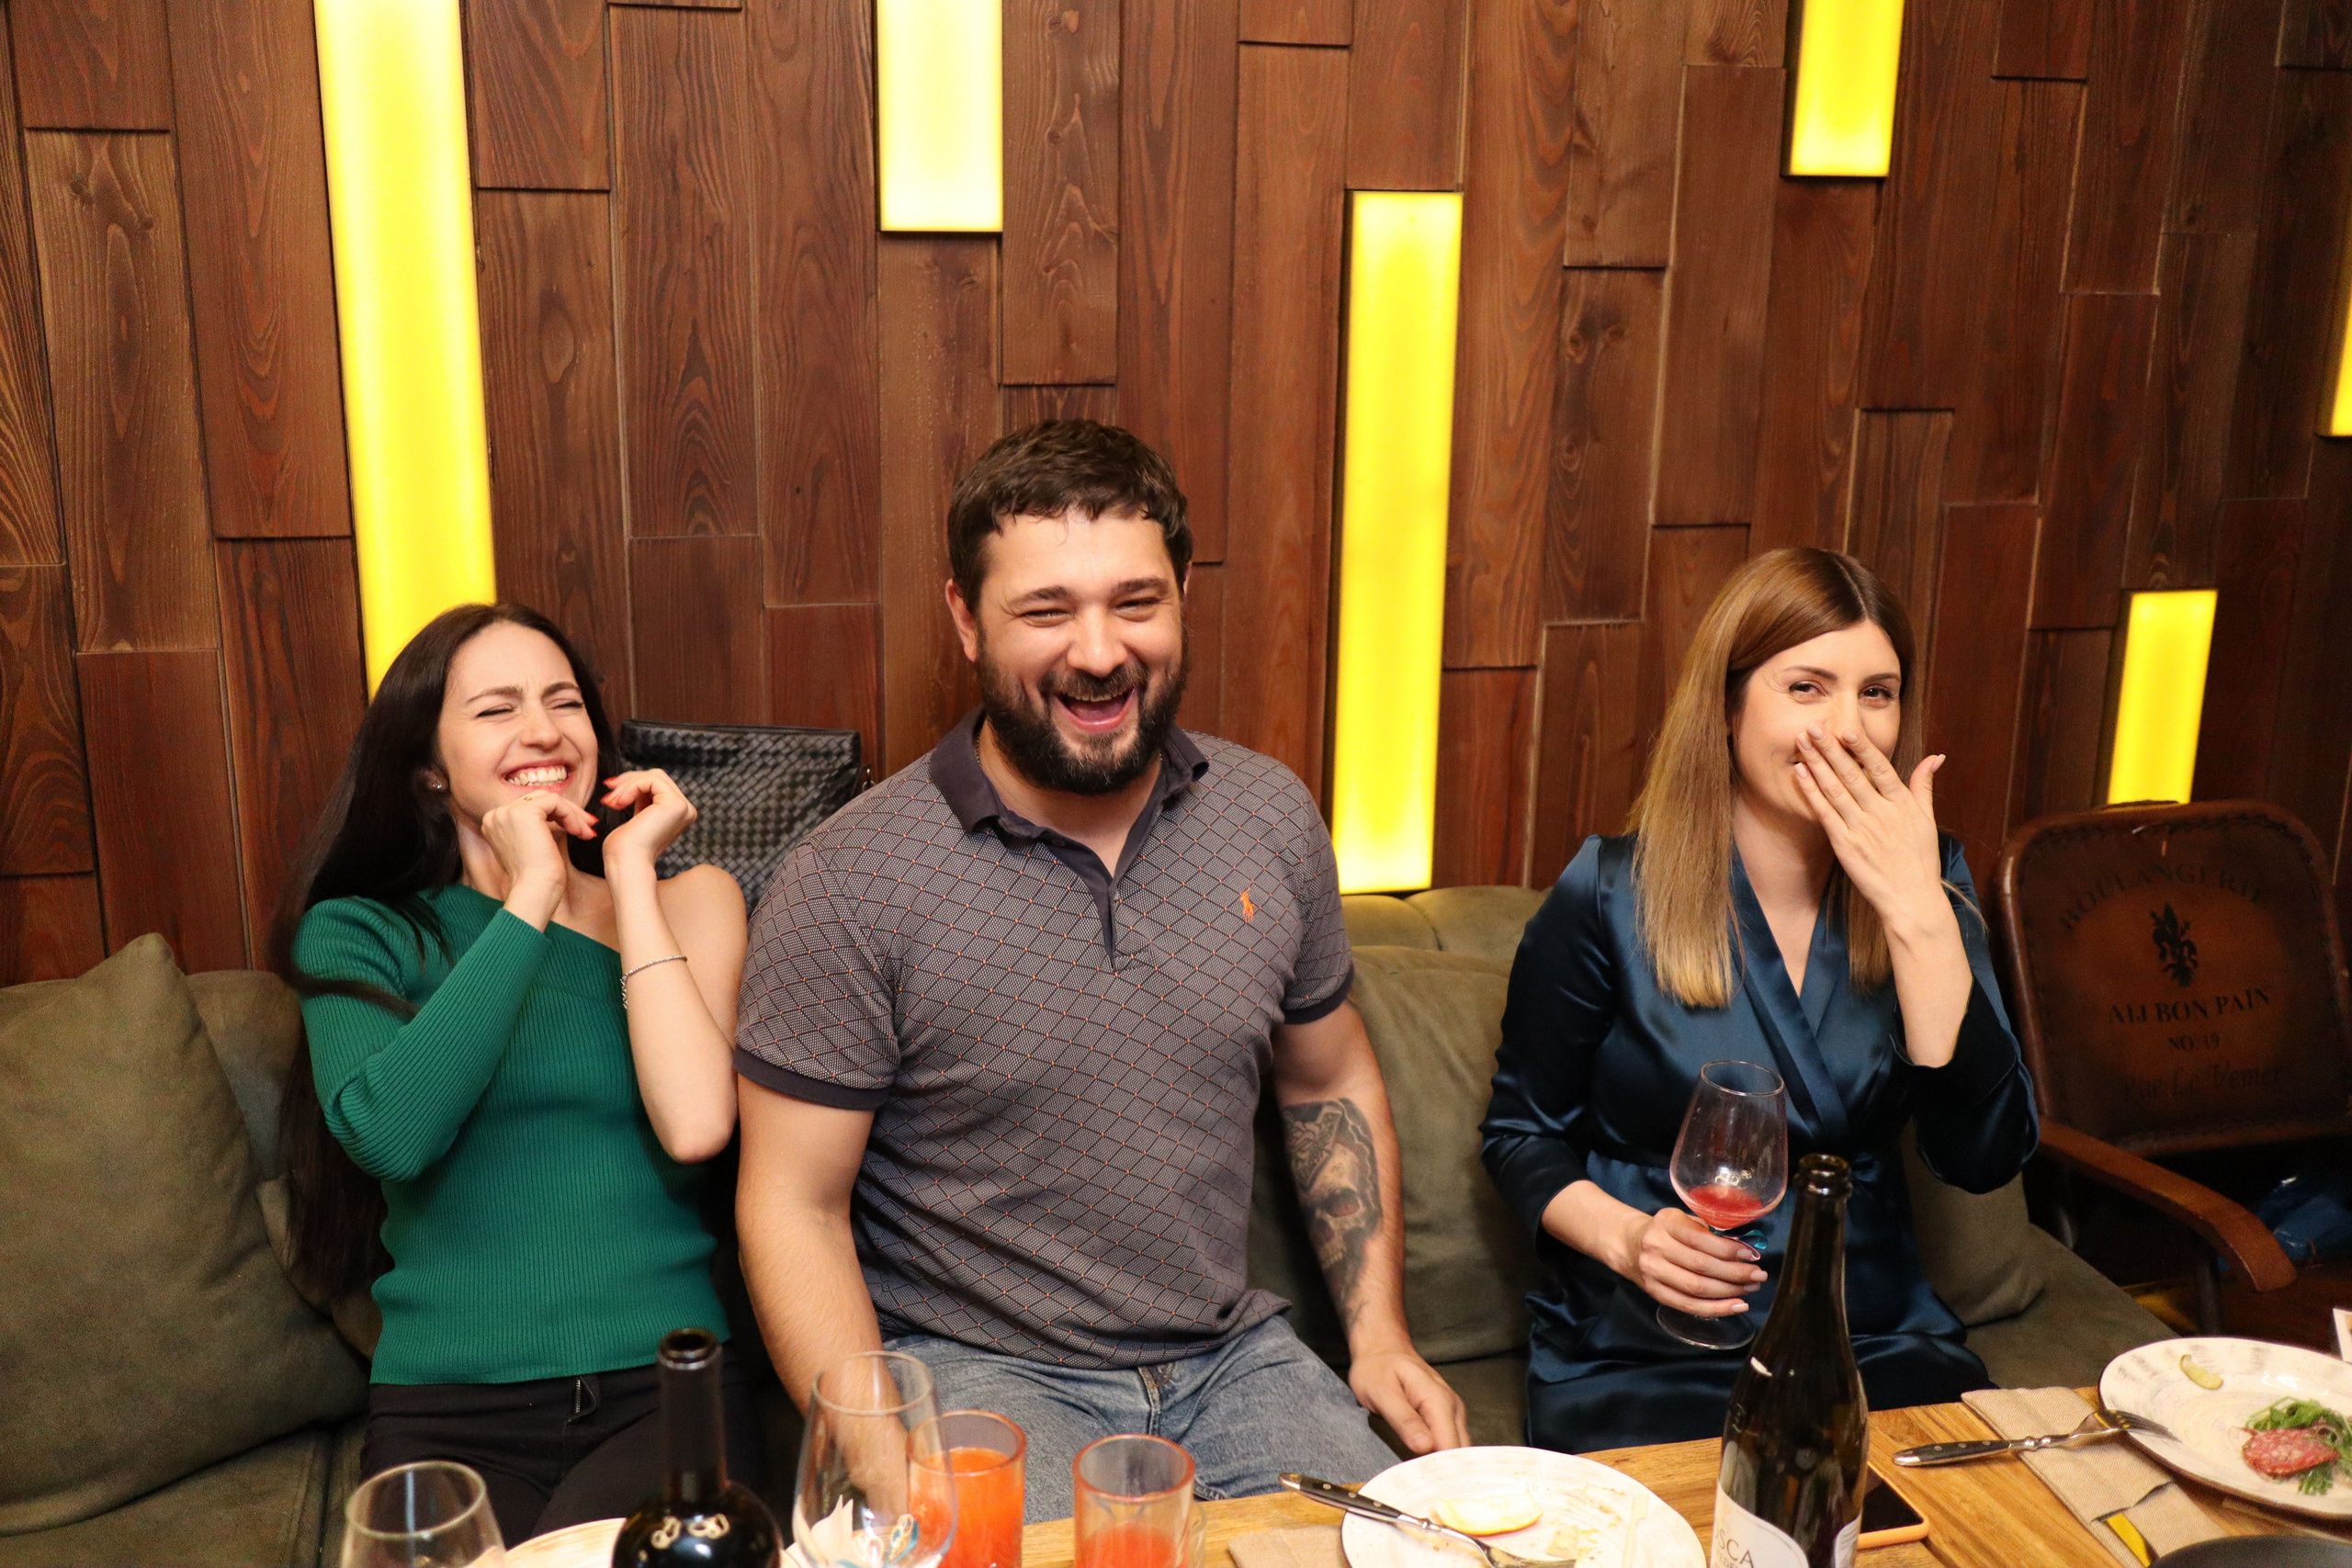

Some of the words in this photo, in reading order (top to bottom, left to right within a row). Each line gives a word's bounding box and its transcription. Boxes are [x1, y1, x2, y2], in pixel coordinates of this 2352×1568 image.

[2154, 999, 2210, 1023] BON
[2215, 988, 2271, 1016] PAIN
[2203, 1032, 2221, 1051] 19
[1715, 1529, 1754, 1568] SCA
